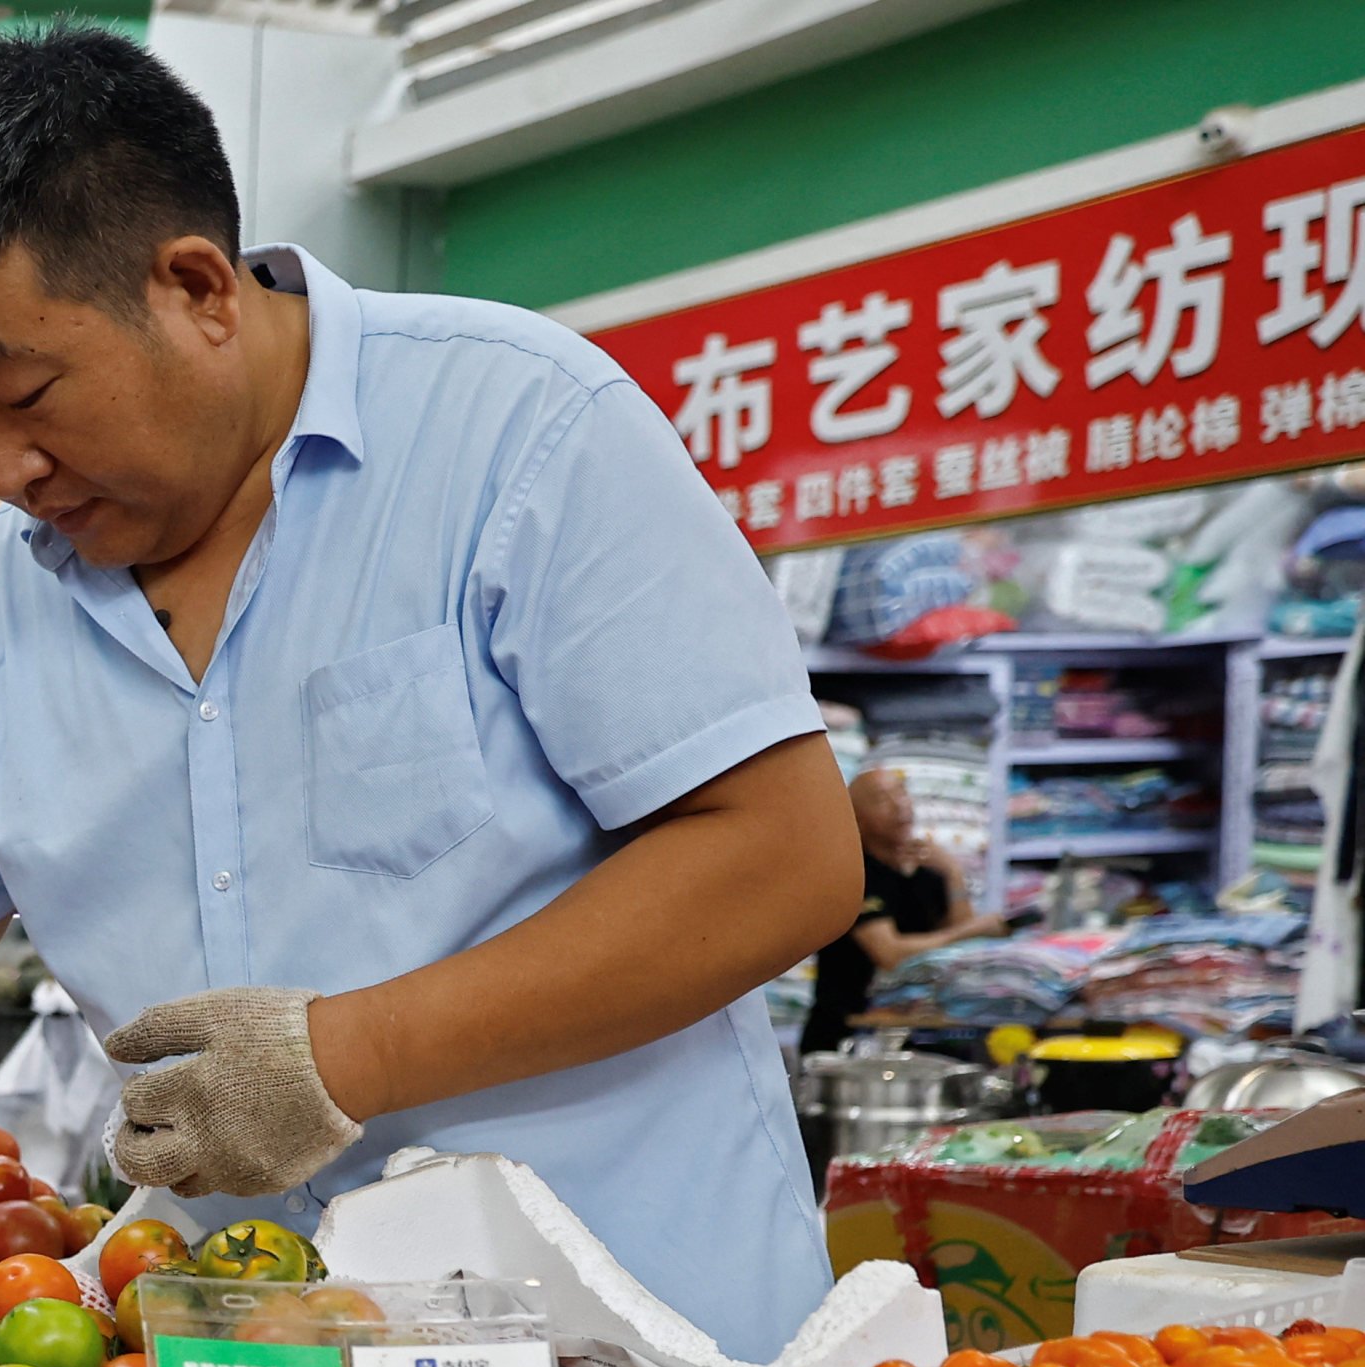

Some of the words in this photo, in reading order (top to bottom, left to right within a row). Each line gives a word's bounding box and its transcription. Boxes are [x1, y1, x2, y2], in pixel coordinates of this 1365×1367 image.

[671, 175, 1365, 470] 布艺家纺现
[796, 455, 921, 521] 四件套
